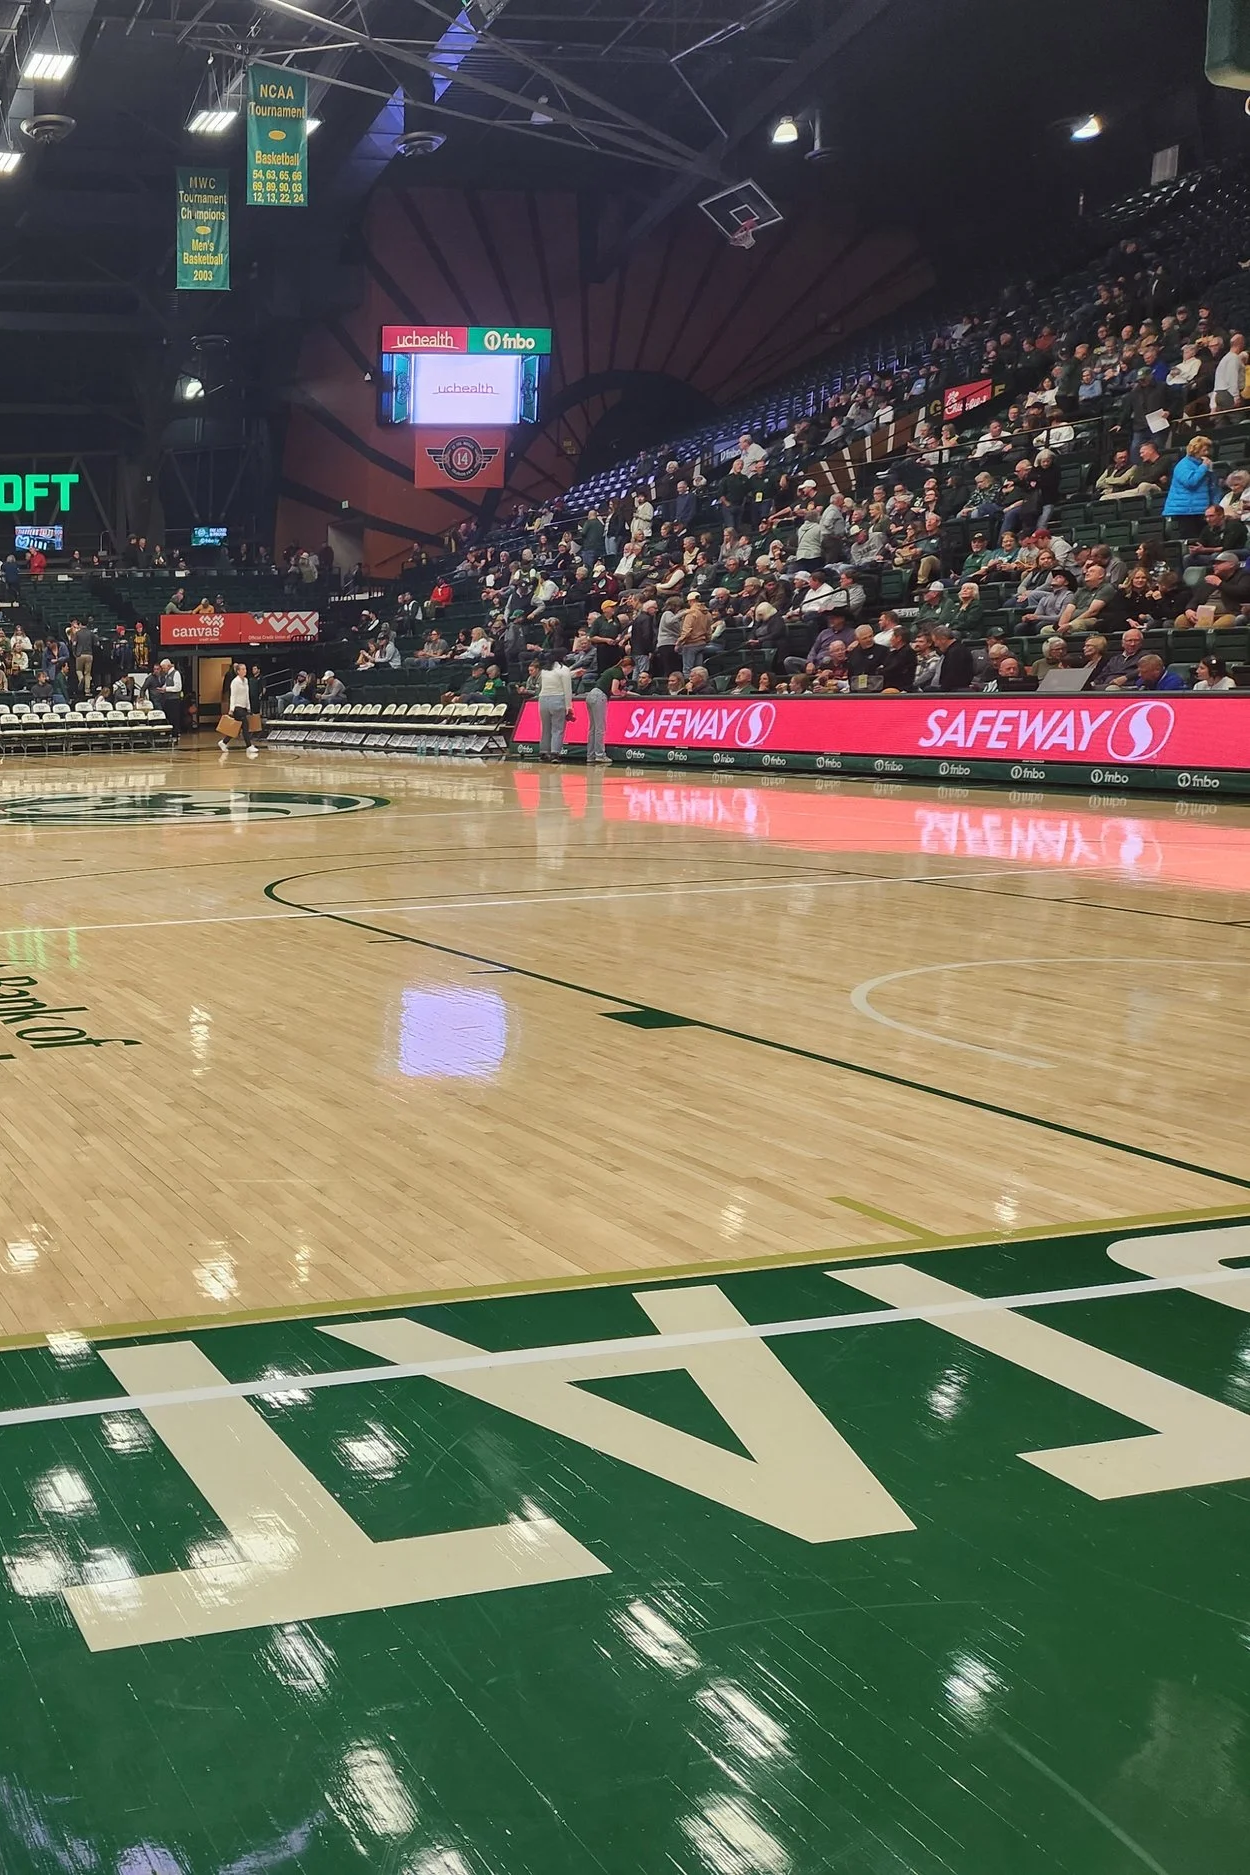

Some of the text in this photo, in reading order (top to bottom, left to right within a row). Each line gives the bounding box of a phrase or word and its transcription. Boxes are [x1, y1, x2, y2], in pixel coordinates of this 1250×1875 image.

[259, 83, 294, 100] NCAA
[249, 101, 306, 119] Tournament
[255, 150, 300, 166] Basketball
[189, 176, 216, 190] MWC
[178, 190, 227, 205] Tournament
[191, 239, 215, 252] Men's
[183, 252, 224, 266] Basketball
[193, 270, 213, 282] 2003
[396, 330, 454, 348] uchealth
[502, 332, 536, 350] fnbo
[437, 382, 494, 394] uchealth
[457, 452, 468, 466] 14
[172, 627, 220, 638] canvas
[623, 706, 740, 742] SAFEWAY
[916, 708, 1114, 752] SAFEWAY
[770, 755, 787, 767] fnbo
[824, 757, 842, 769] fnbo
[883, 760, 904, 772] fnbo
[949, 764, 971, 776] fnbo
[1022, 766, 1046, 780] fnbo
[1103, 769, 1129, 784] fnbo
[1191, 774, 1220, 789] fnbo
[15, 1026, 143, 1050] of
